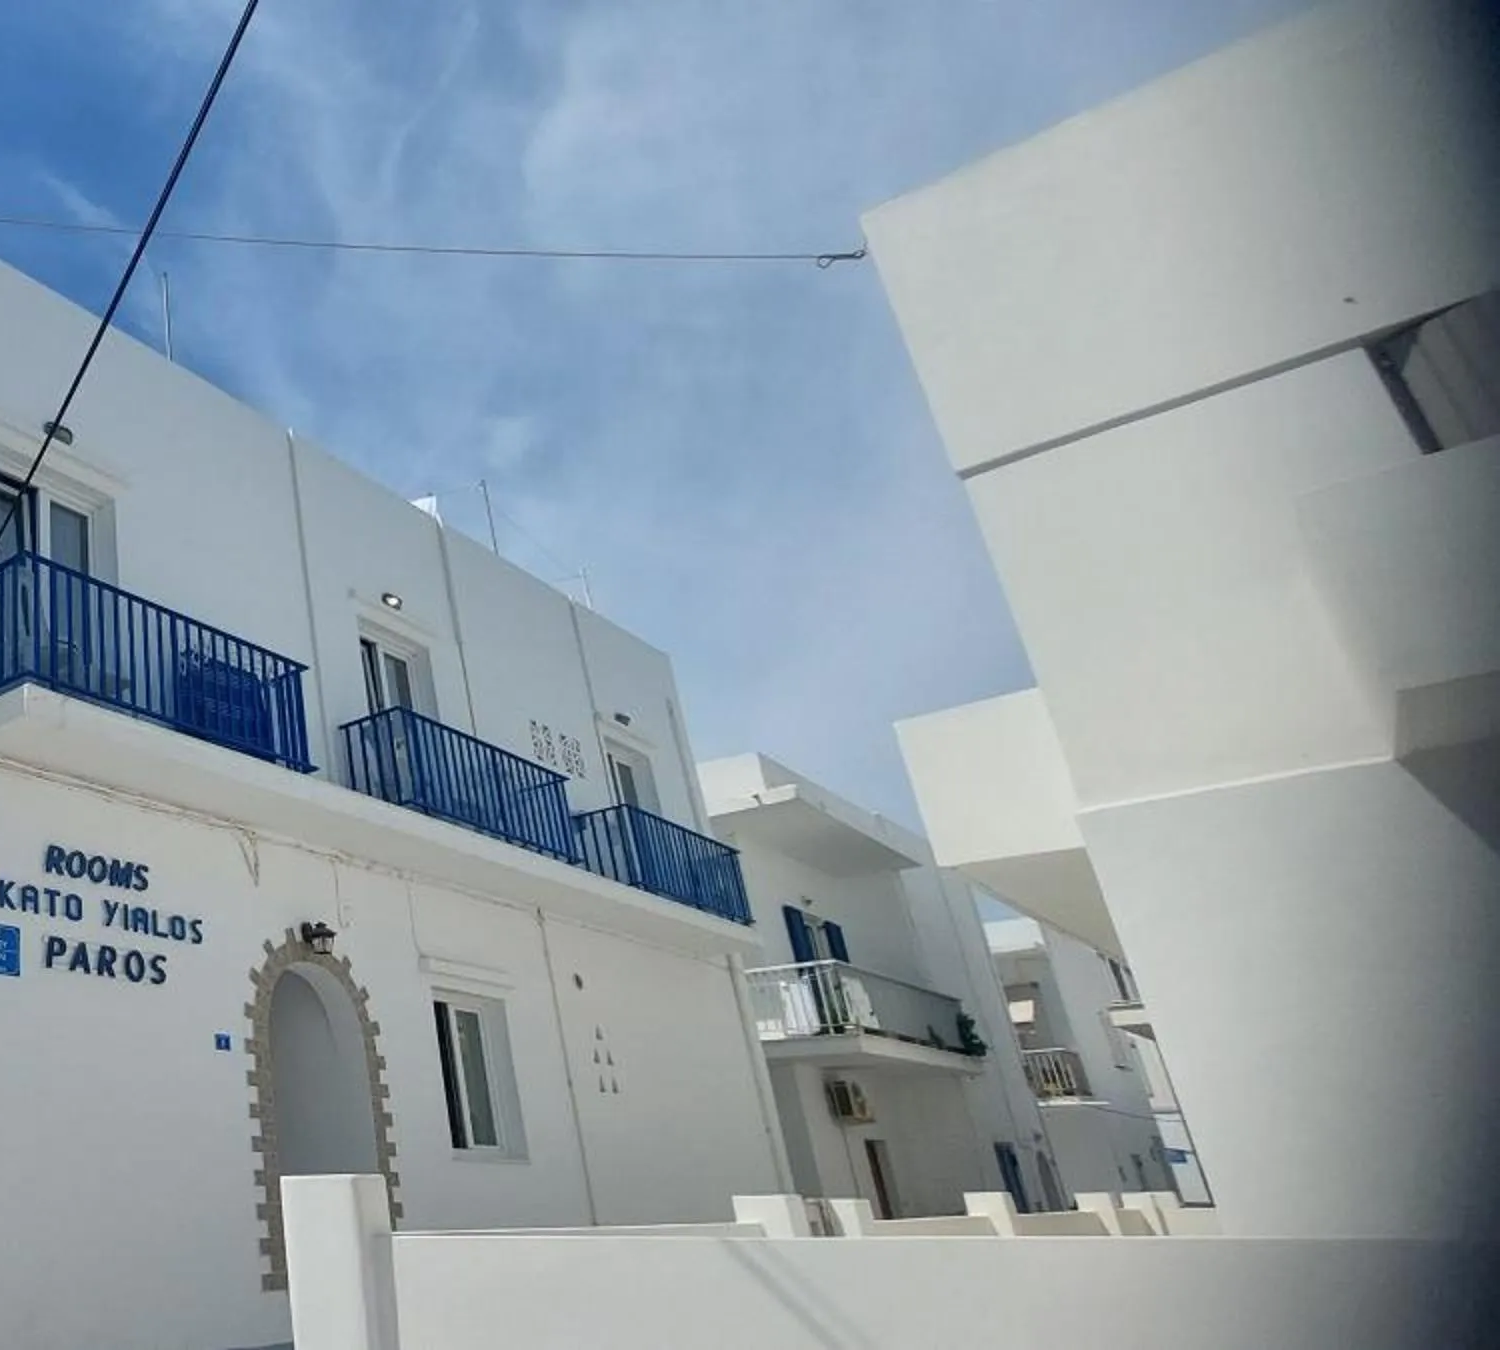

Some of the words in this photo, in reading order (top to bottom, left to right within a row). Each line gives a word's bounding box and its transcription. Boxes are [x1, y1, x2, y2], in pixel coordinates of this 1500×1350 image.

[44, 844, 150, 892] ROOMS
[102, 899, 204, 945] YIALOS
[44, 935, 168, 985] PAROS
